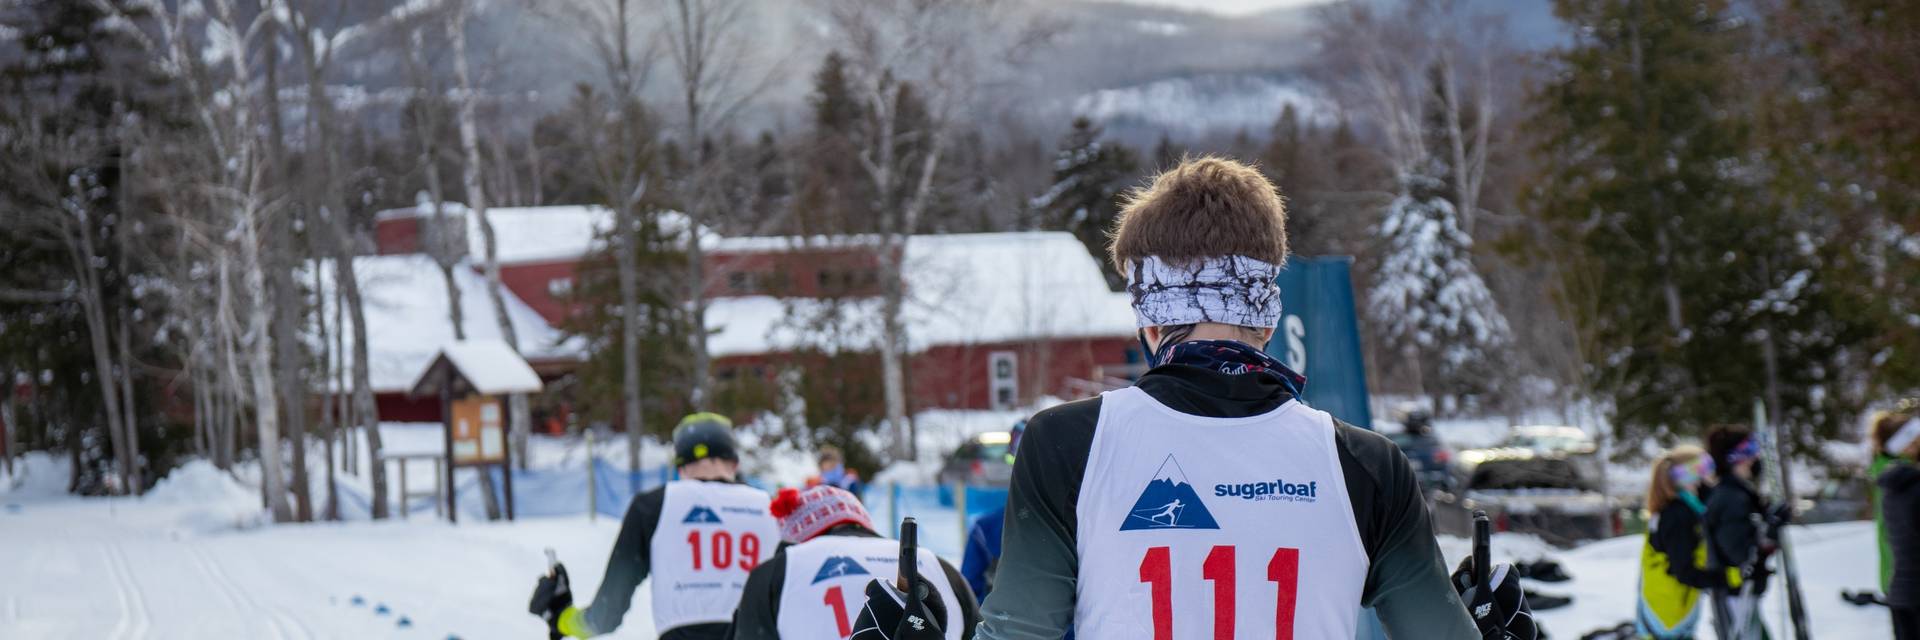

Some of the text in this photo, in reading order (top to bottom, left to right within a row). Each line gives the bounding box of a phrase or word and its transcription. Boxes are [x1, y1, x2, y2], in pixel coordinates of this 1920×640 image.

[1214, 479, 1317, 499] sugarloaf
[1268, 494, 1293, 503] Touring
[687, 530, 760, 571] 109
[1139, 545, 1299, 640] 111
